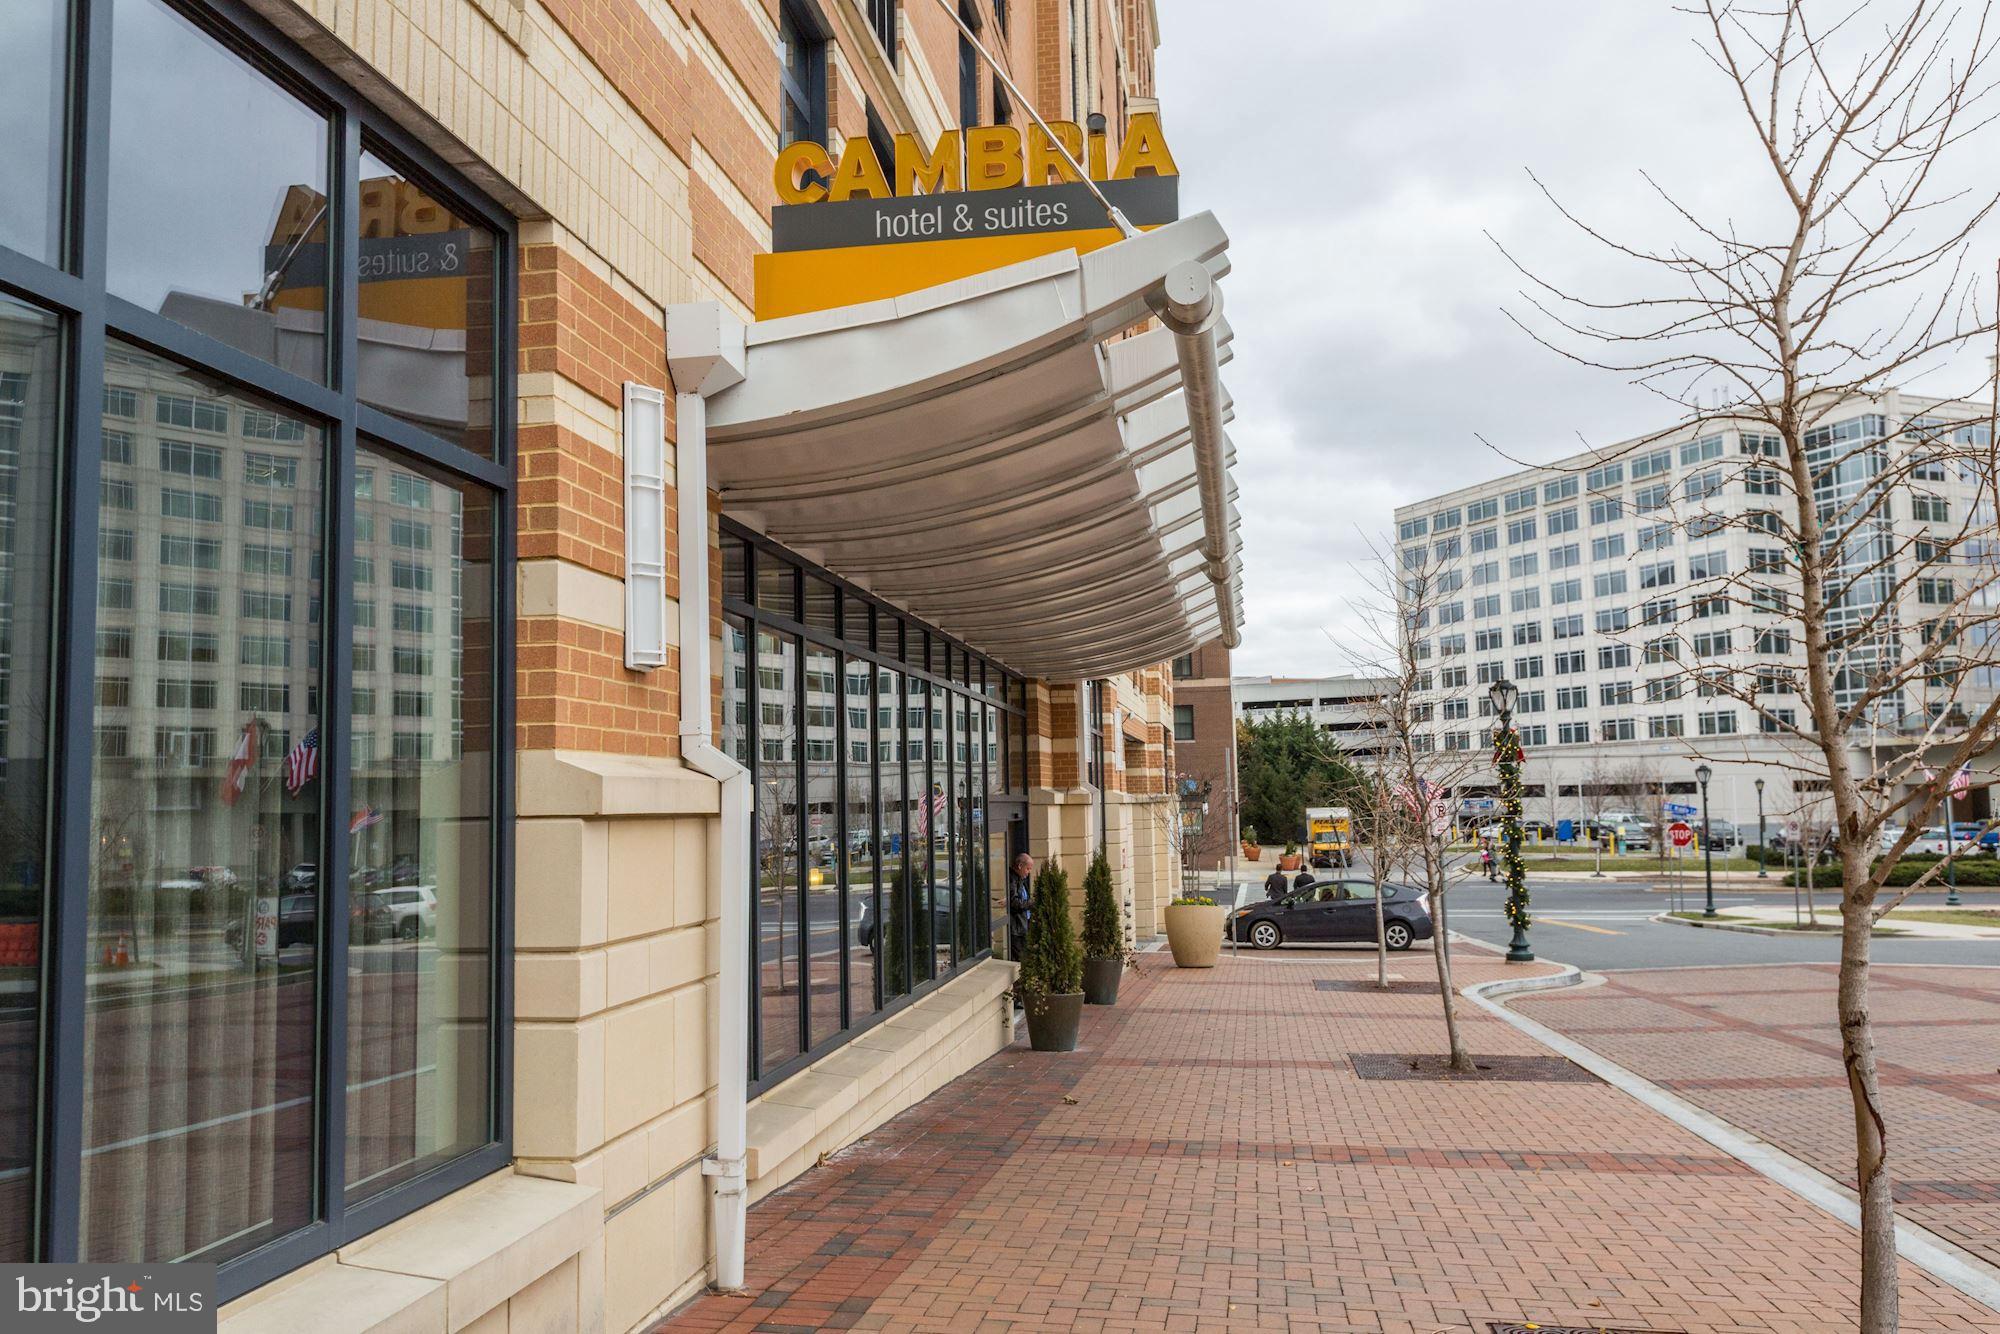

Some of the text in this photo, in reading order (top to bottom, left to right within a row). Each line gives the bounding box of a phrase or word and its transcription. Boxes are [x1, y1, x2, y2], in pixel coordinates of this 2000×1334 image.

[876, 199, 1069, 238] hotel & suites
